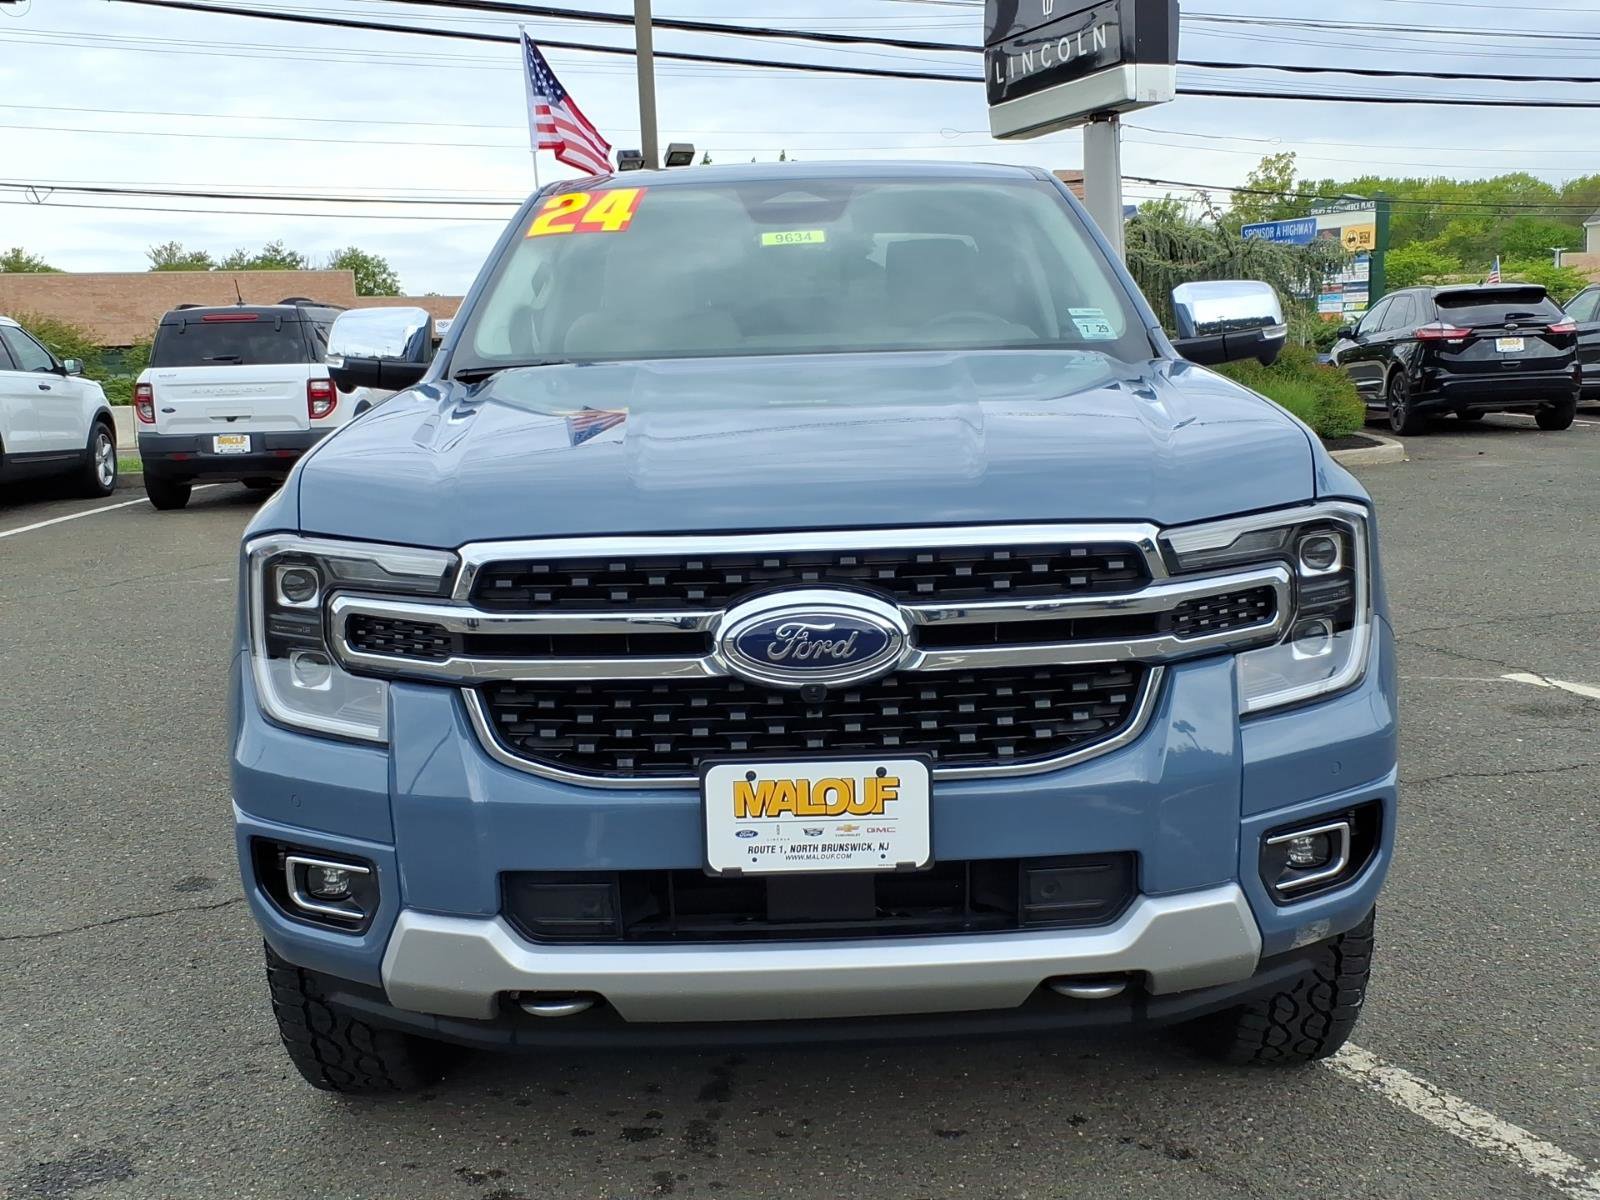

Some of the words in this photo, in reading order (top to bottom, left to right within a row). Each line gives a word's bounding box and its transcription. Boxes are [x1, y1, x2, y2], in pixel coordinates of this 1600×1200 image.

[996, 24, 1107, 84] LINCOLN
[526, 188, 641, 238] 24
[775, 232, 812, 243] 9634
[1244, 226, 1275, 239] SPONSOR
[1276, 226, 1281, 237] A
[1282, 222, 1314, 237] HIGHWAY
[767, 621, 859, 660] Ford
[732, 776, 901, 818] MALOUF
[866, 826, 896, 834] GMC
[747, 845, 776, 855] ROUTE
[779, 845, 787, 855] 1,
[790, 844, 819, 854] NORTH
[821, 842, 876, 853] BRUNSWICK,
[878, 842, 890, 851] NJ
[785, 853, 852, 861] WWW.MALOUF.COM
